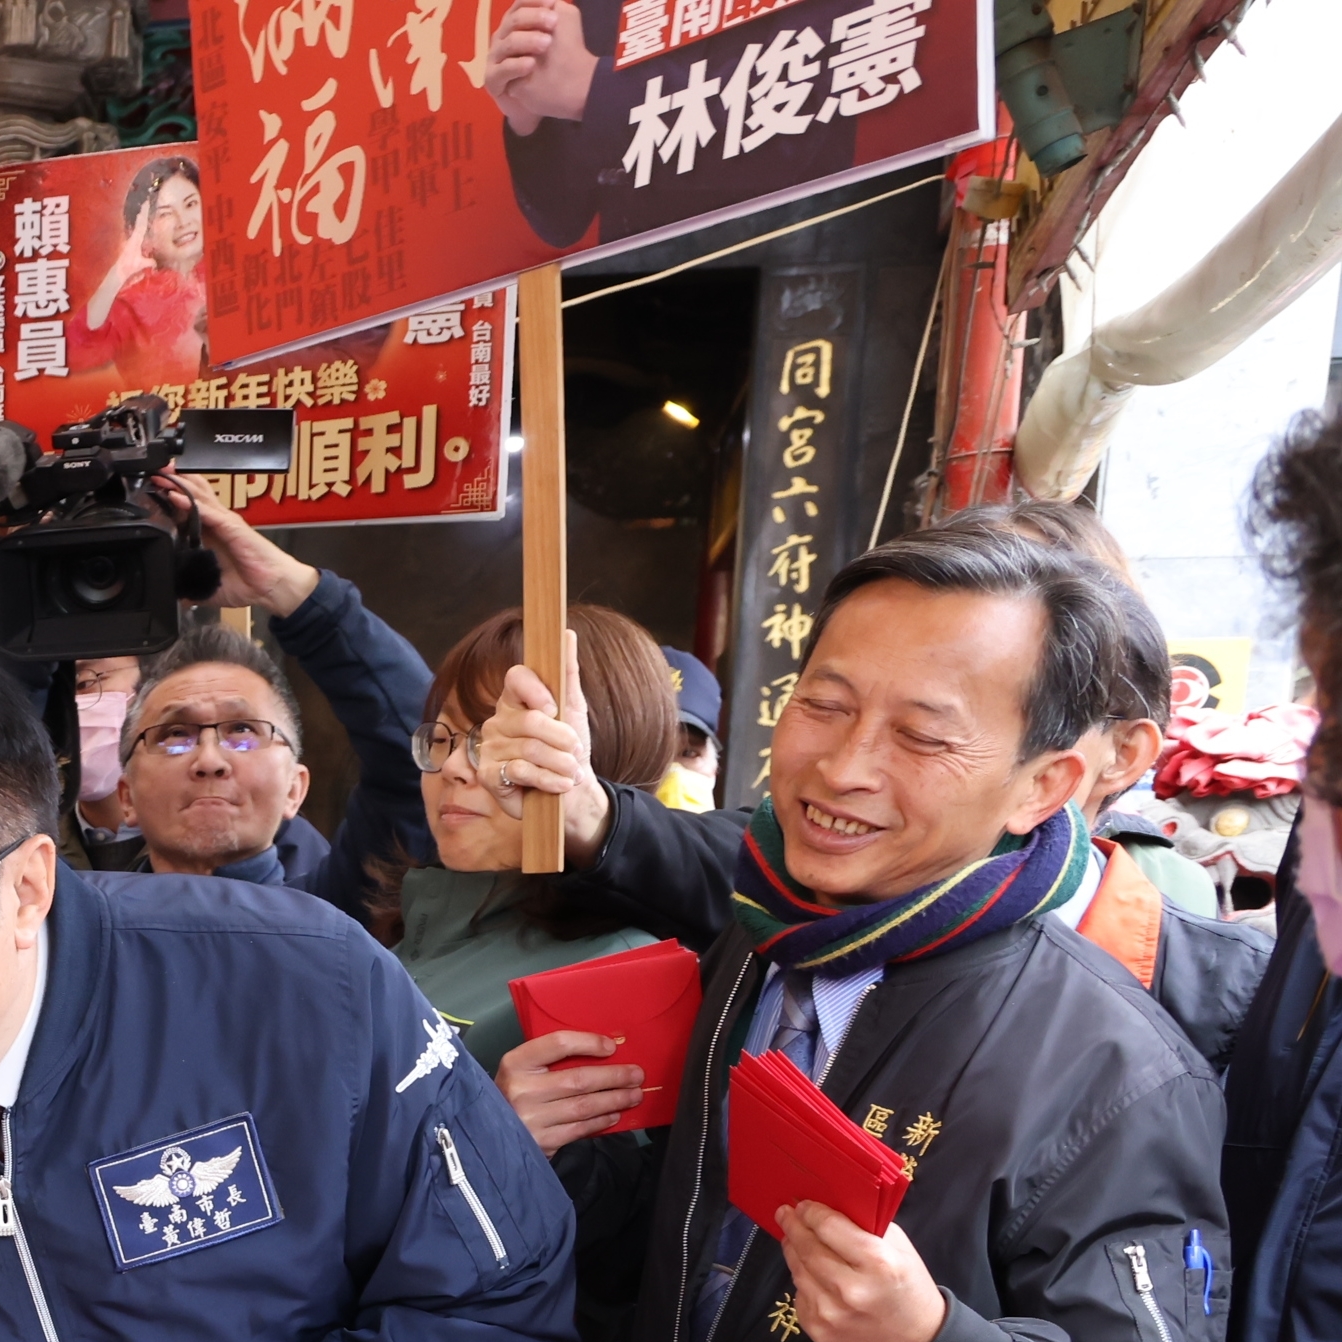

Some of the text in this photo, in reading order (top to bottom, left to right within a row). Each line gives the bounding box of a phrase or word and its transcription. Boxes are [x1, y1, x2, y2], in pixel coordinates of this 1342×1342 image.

[622, 0, 934, 188] 林俊憲
[202, 102, 231, 184] 安平
[368, 105, 401, 194] 學甲
[405, 116, 441, 208] 將軍
[441, 119, 477, 216] 山上
[14, 195, 71, 381] 賴惠員
[207, 194, 239, 319] 中西區
[242, 247, 270, 335] 新化
[273, 245, 305, 331] 北門
[374, 205, 408, 296] 佳里
[468, 320, 493, 407] 台南最好
[63, 460, 91, 469] SONY
[214, 433, 264, 443] XDCAM
[138, 1184, 247, 1244] 臺南市長
[162, 1208, 232, 1247] 黃偉哲
